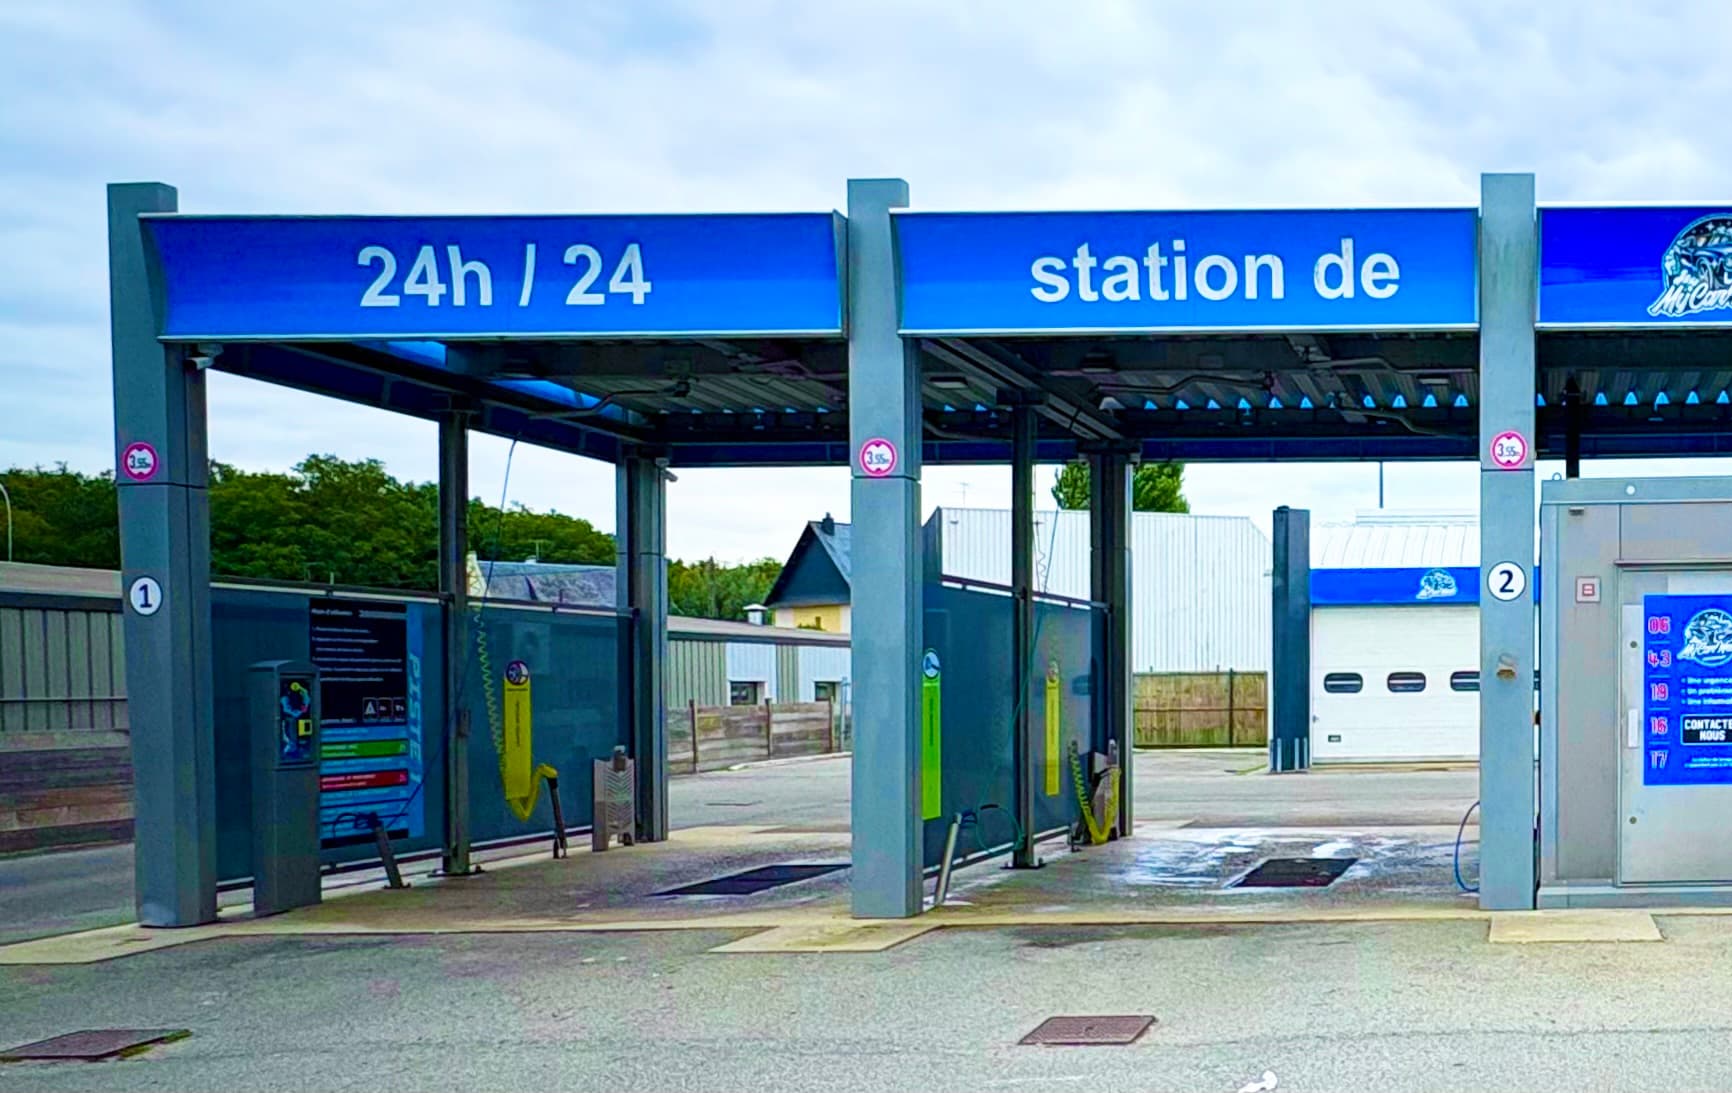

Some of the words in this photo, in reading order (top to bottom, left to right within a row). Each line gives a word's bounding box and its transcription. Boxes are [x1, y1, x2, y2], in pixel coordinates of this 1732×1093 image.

[358, 245, 493, 307] 24h
[519, 243, 536, 307] /
[563, 243, 652, 305] 24
[1030, 239, 1285, 302] station
[1313, 238, 1401, 299] de
[1499, 569, 1515, 593] 2
[138, 583, 153, 608] 1
[1647, 616, 1671, 634] 06
[1647, 650, 1672, 667] 43
[1699, 730, 1726, 741] NOUS
